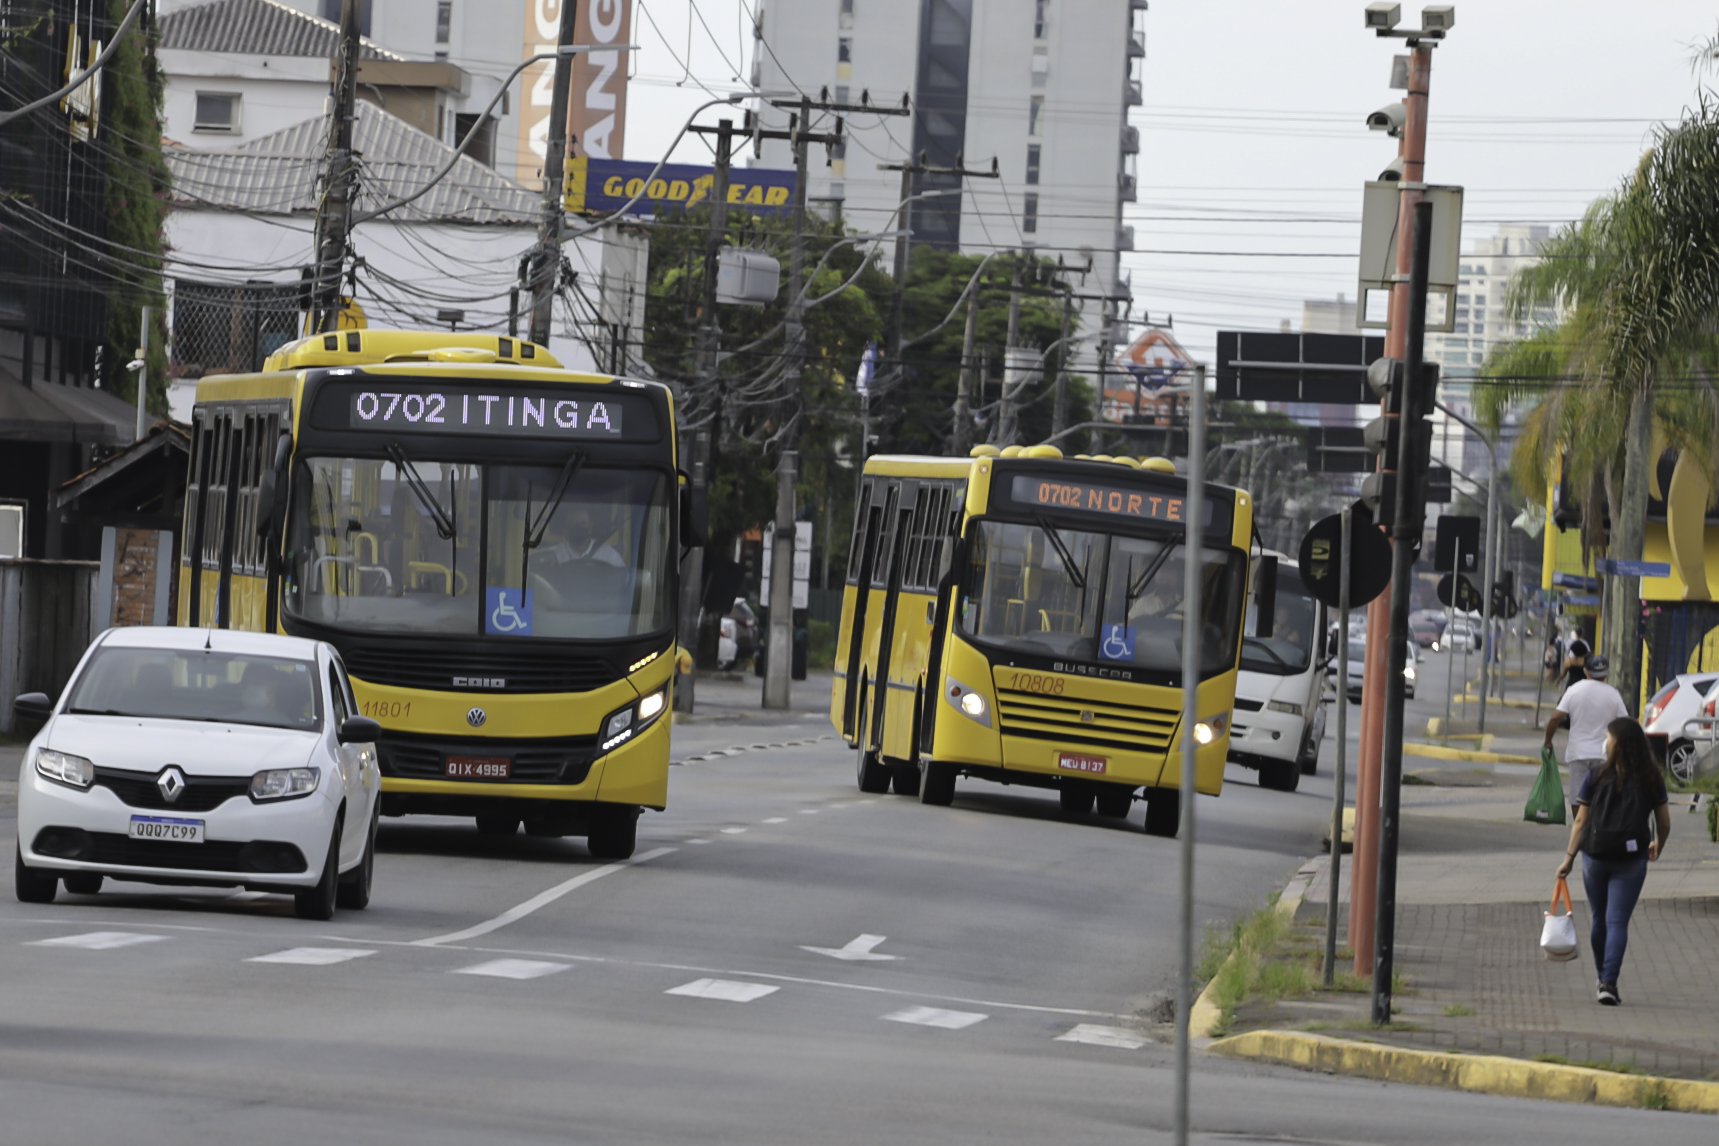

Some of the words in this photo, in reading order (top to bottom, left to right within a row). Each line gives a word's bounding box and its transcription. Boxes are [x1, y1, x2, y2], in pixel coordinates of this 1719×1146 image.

[603, 175, 789, 206] GOODEAR
[357, 392, 446, 423] 0702
[462, 394, 611, 430] ITINGA
[1038, 482, 1082, 507] 0702
[1088, 489, 1183, 520] NORTE
[1053, 662, 1132, 679] BUSSCAR
[1010, 673, 1065, 695] 10808
[363, 701, 411, 718] 11801
[137, 823, 197, 840] QQQ7C99
